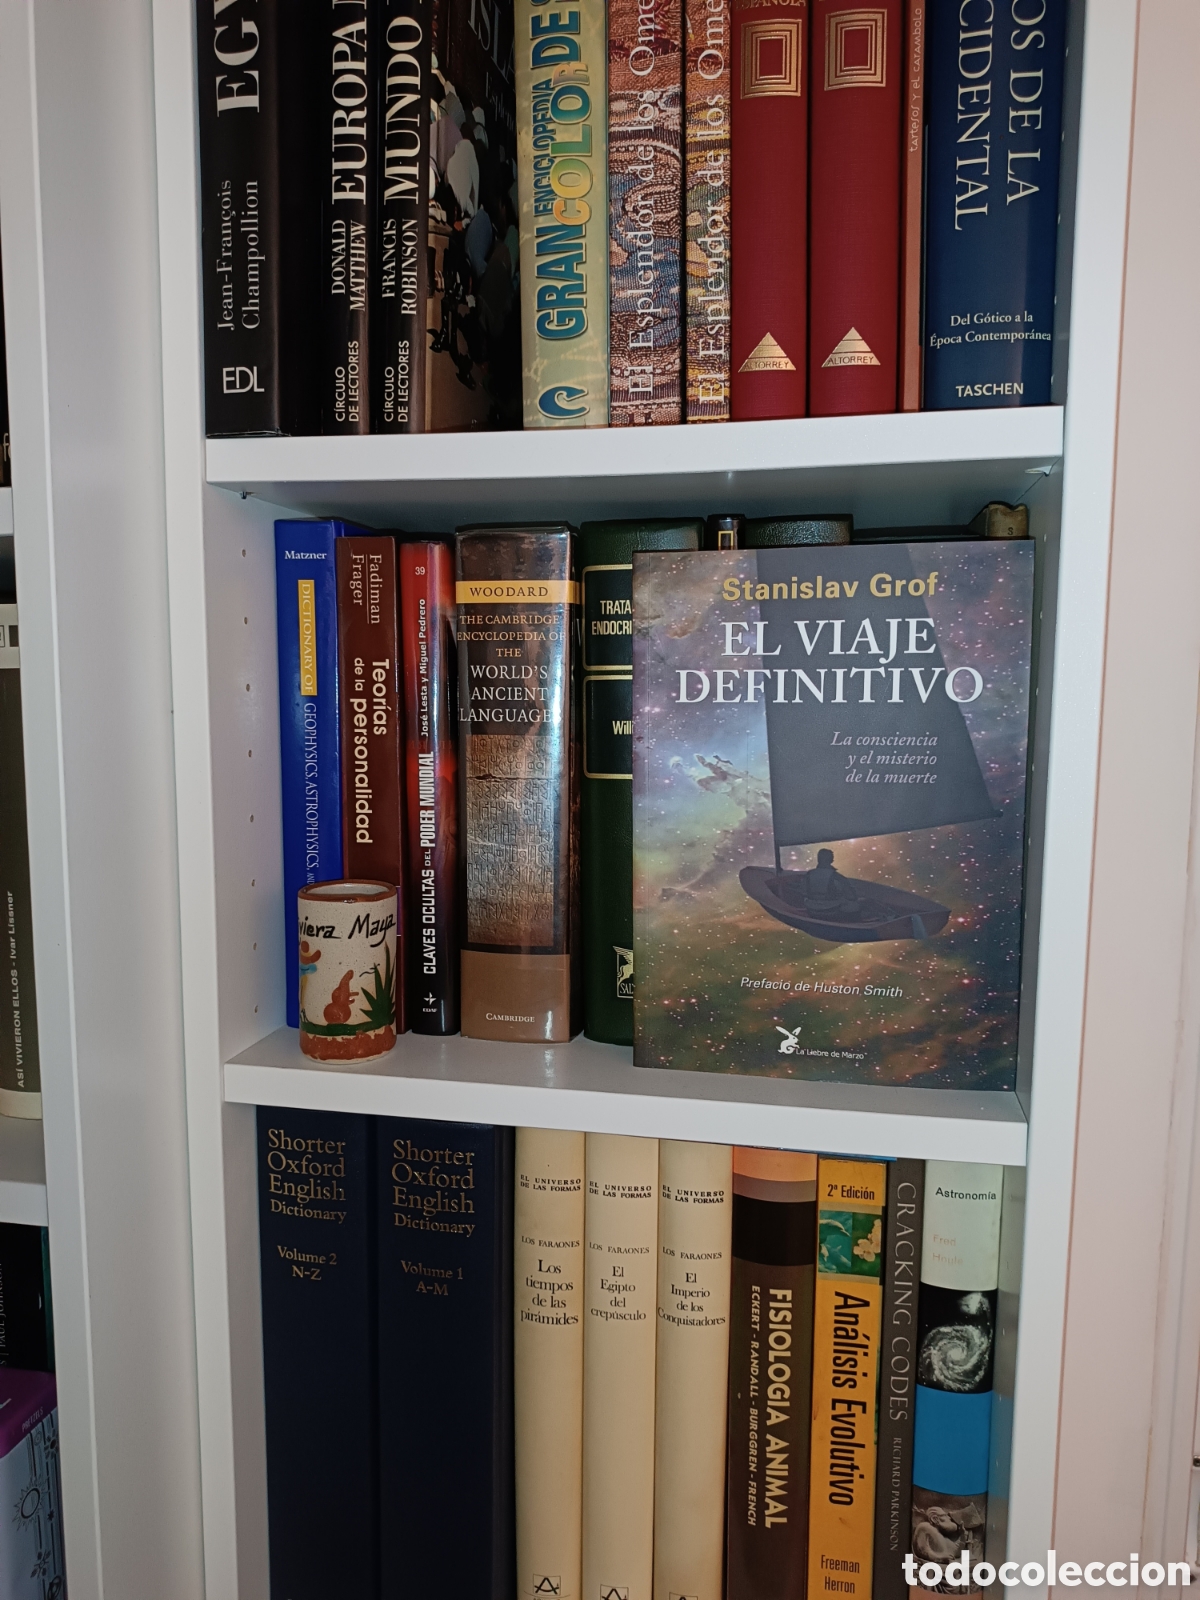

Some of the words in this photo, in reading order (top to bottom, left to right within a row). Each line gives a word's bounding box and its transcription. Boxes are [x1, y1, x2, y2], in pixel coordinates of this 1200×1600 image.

[331, 17, 368, 205] EUROPA
[384, 16, 423, 205] MUNDO
[628, 90, 655, 133] los
[1008, 68, 1044, 134] DE
[697, 93, 725, 141] los
[549, 62, 593, 226] COLOR
[628, 145, 655, 182] de
[697, 150, 725, 187] de
[1006, 148, 1041, 206] LA
[216, 180, 236, 331] Jean-François
[240, 180, 266, 329] Champollion
[331, 219, 346, 295] DONALD
[350, 219, 366, 312] MATTHEW
[381, 218, 397, 298] FRANCIS
[401, 218, 419, 315] ROBINSON
[534, 223, 588, 340] GRAN
[627, 196, 662, 350] Esplendor
[697, 200, 730, 360] Esplendor
[950, 313, 971, 327] Del
[973, 312, 1012, 324] Gótico
[1023, 310, 1034, 323] la
[929, 333, 962, 349] Época
[965, 328, 1051, 344] Contemporánea
[348, 340, 359, 402] LECTORES
[398, 340, 409, 402] LECTORES
[744, 360, 789, 370] ALTORREY
[827, 354, 874, 365] ALTORREY
[334, 366, 346, 422] CÍRCULO
[383, 366, 395, 422] CÍRCULO
[628, 365, 653, 396] El
[698, 372, 725, 405] El
[955, 382, 1024, 398] TASCHEN
[349, 407, 359, 422] DE
[397, 407, 408, 423] DE
[284, 550, 327, 560] Matzner
[350, 554, 365, 605] Frager
[415, 566, 426, 576] 39
[369, 554, 383, 624] Fadiman
[469, 586, 549, 598] WOODARD
[722, 575, 859, 601] Stanislav
[869, 571, 939, 598] Grof
[302, 583, 313, 671] DICTIONARY
[418, 598, 427, 639] Pedrero
[459, 615, 483, 625] THE
[485, 614, 560, 625] CAMBRIDGE
[456, 631, 546, 641] ENCYCLOPEDIA
[720, 621, 782, 657] EL
[793, 617, 936, 664] VIAJE
[354, 657, 365, 675] de
[419, 639, 429, 674] Miguel
[495, 648, 522, 658] THE
[304, 673, 314, 693] OF
[355, 679, 366, 691] la
[372, 658, 392, 735] Teorías
[470, 686, 550, 701] ANCIENT
[674, 666, 984, 704] DEFINITIVO
[420, 685, 428, 713] Lesta
[420, 715, 429, 737] José
[830, 731, 852, 746] La
[856, 732, 938, 747] consciencia
[304, 702, 318, 780] GEOPHYSICS,
[350, 699, 374, 844] personalidad
[845, 753, 856, 769] y
[859, 750, 873, 765] el
[876, 751, 937, 765] misterio
[418, 751, 435, 806] MUNDIAL
[845, 769, 862, 783] de
[865, 769, 880, 784] la
[884, 772, 937, 784] muerte
[305, 781, 320, 871] ASTROPHYSICS,
[419, 809, 436, 848] PODER
[421, 869, 435, 924] OCULTAS
[7, 891, 16, 935] Lissner
[348, 913, 397, 948] Maya
[9, 936, 17, 959] Ivar
[422, 928, 436, 975] CLAVES
[11, 969, 20, 1007] ELLOS
[740, 977, 791, 991] Prefacio
[794, 981, 810, 992] de
[813, 982, 860, 995] Huston
[863, 985, 903, 998] Smith
[13, 1010, 23, 1065] VIVIERON
[806, 1049, 829, 1057] Liebre
[841, 1051, 865, 1060] Marzo
[16, 1068, 25, 1088] ASÍ
[267, 1128, 346, 1155] Shorter
[392, 1138, 475, 1166] Shorter
[267, 1151, 346, 1177] Oxford
[391, 1162, 475, 1189] Oxford
[520, 1174, 530, 1182] EL
[268, 1173, 347, 1204] English
[392, 1185, 475, 1217] English
[604, 1184, 652, 1192] UNIVERSO
[620, 1191, 652, 1199] FORMAS
[840, 1184, 875, 1201] Edición
[935, 1187, 997, 1201] Astronomía
[270, 1198, 347, 1224] Dictionary
[393, 1212, 476, 1238] Dictionary
[277, 1245, 326, 1265] Volume
[329, 1253, 338, 1265] 2
[521, 1235, 536, 1246] LOS
[538, 1239, 580, 1249] FARAONES
[589, 1241, 603, 1251] LOS
[607, 1245, 650, 1255] FARAONES
[662, 1246, 676, 1257] LOS
[680, 1251, 722, 1260] FARAONES
[892, 1182, 917, 1326] CRACKING
[291, 1265, 322, 1281] N-Z
[401, 1260, 453, 1279] Volume
[537, 1259, 562, 1274] Los
[611, 1265, 625, 1278] El
[685, 1272, 698, 1284] El
[416, 1281, 449, 1296] A-M
[525, 1275, 574, 1294] tiempos
[600, 1278, 636, 1294] Egipto
[670, 1284, 711, 1300] Imperio
[531, 1294, 547, 1307] de
[550, 1294, 567, 1309] las
[590, 1306, 647, 1322] crepúsculo
[609, 1296, 626, 1308] del
[676, 1300, 689, 1311] de
[690, 1300, 704, 1312] los
[751, 1285, 761, 1332] ECKERT
[520, 1309, 579, 1326] pirámides
[657, 1306, 726, 1327] Conquistadores
[831, 1290, 871, 1389] Análisis
[749, 1340, 760, 1398] RANDALL
[765, 1288, 793, 1426] FISIOLOGIA
[889, 1336, 910, 1421] CODES
[748, 1407, 758, 1473] BURGGREN
[828, 1397, 867, 1507] Evolutivo
[891, 1437, 902, 1487] RICHARD
[764, 1432, 790, 1528] ANIMAL
[747, 1479, 757, 1526] FRENCH
[889, 1490, 900, 1551] PARKINSON
[820, 1554, 860, 1574] Freeman
[824, 1575, 856, 1594] Herron
